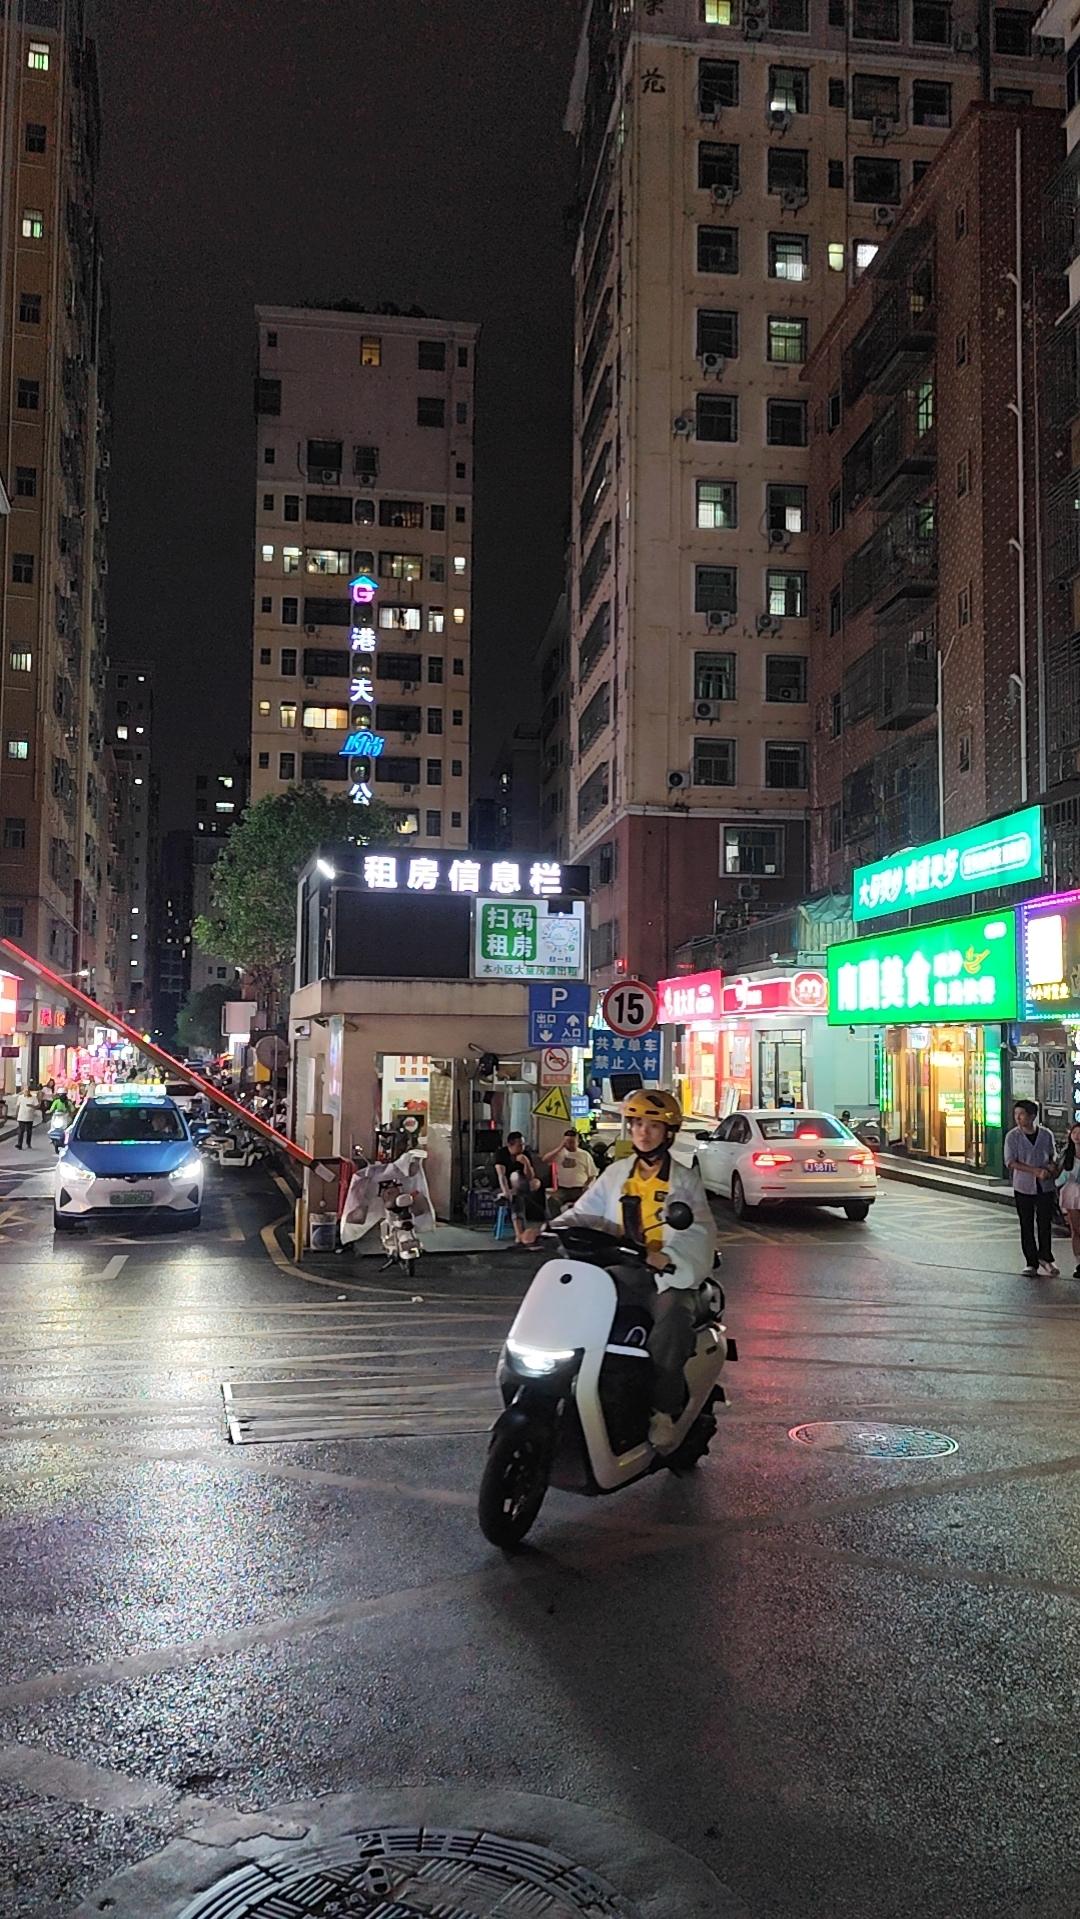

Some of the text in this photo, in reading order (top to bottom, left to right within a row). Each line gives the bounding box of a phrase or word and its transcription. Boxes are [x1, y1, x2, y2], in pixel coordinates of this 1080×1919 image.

[364, 855, 563, 895] 租房信息栏
[487, 907, 534, 931] 扫码
[486, 931, 534, 957] 租房
[551, 987, 568, 1008] P
[536, 1013, 557, 1024] 出口
[614, 992, 645, 1025] 15
[562, 1028, 582, 1038] 入口
[595, 1037, 658, 1053] 共享单车
[595, 1055, 657, 1072] 禁止入村
